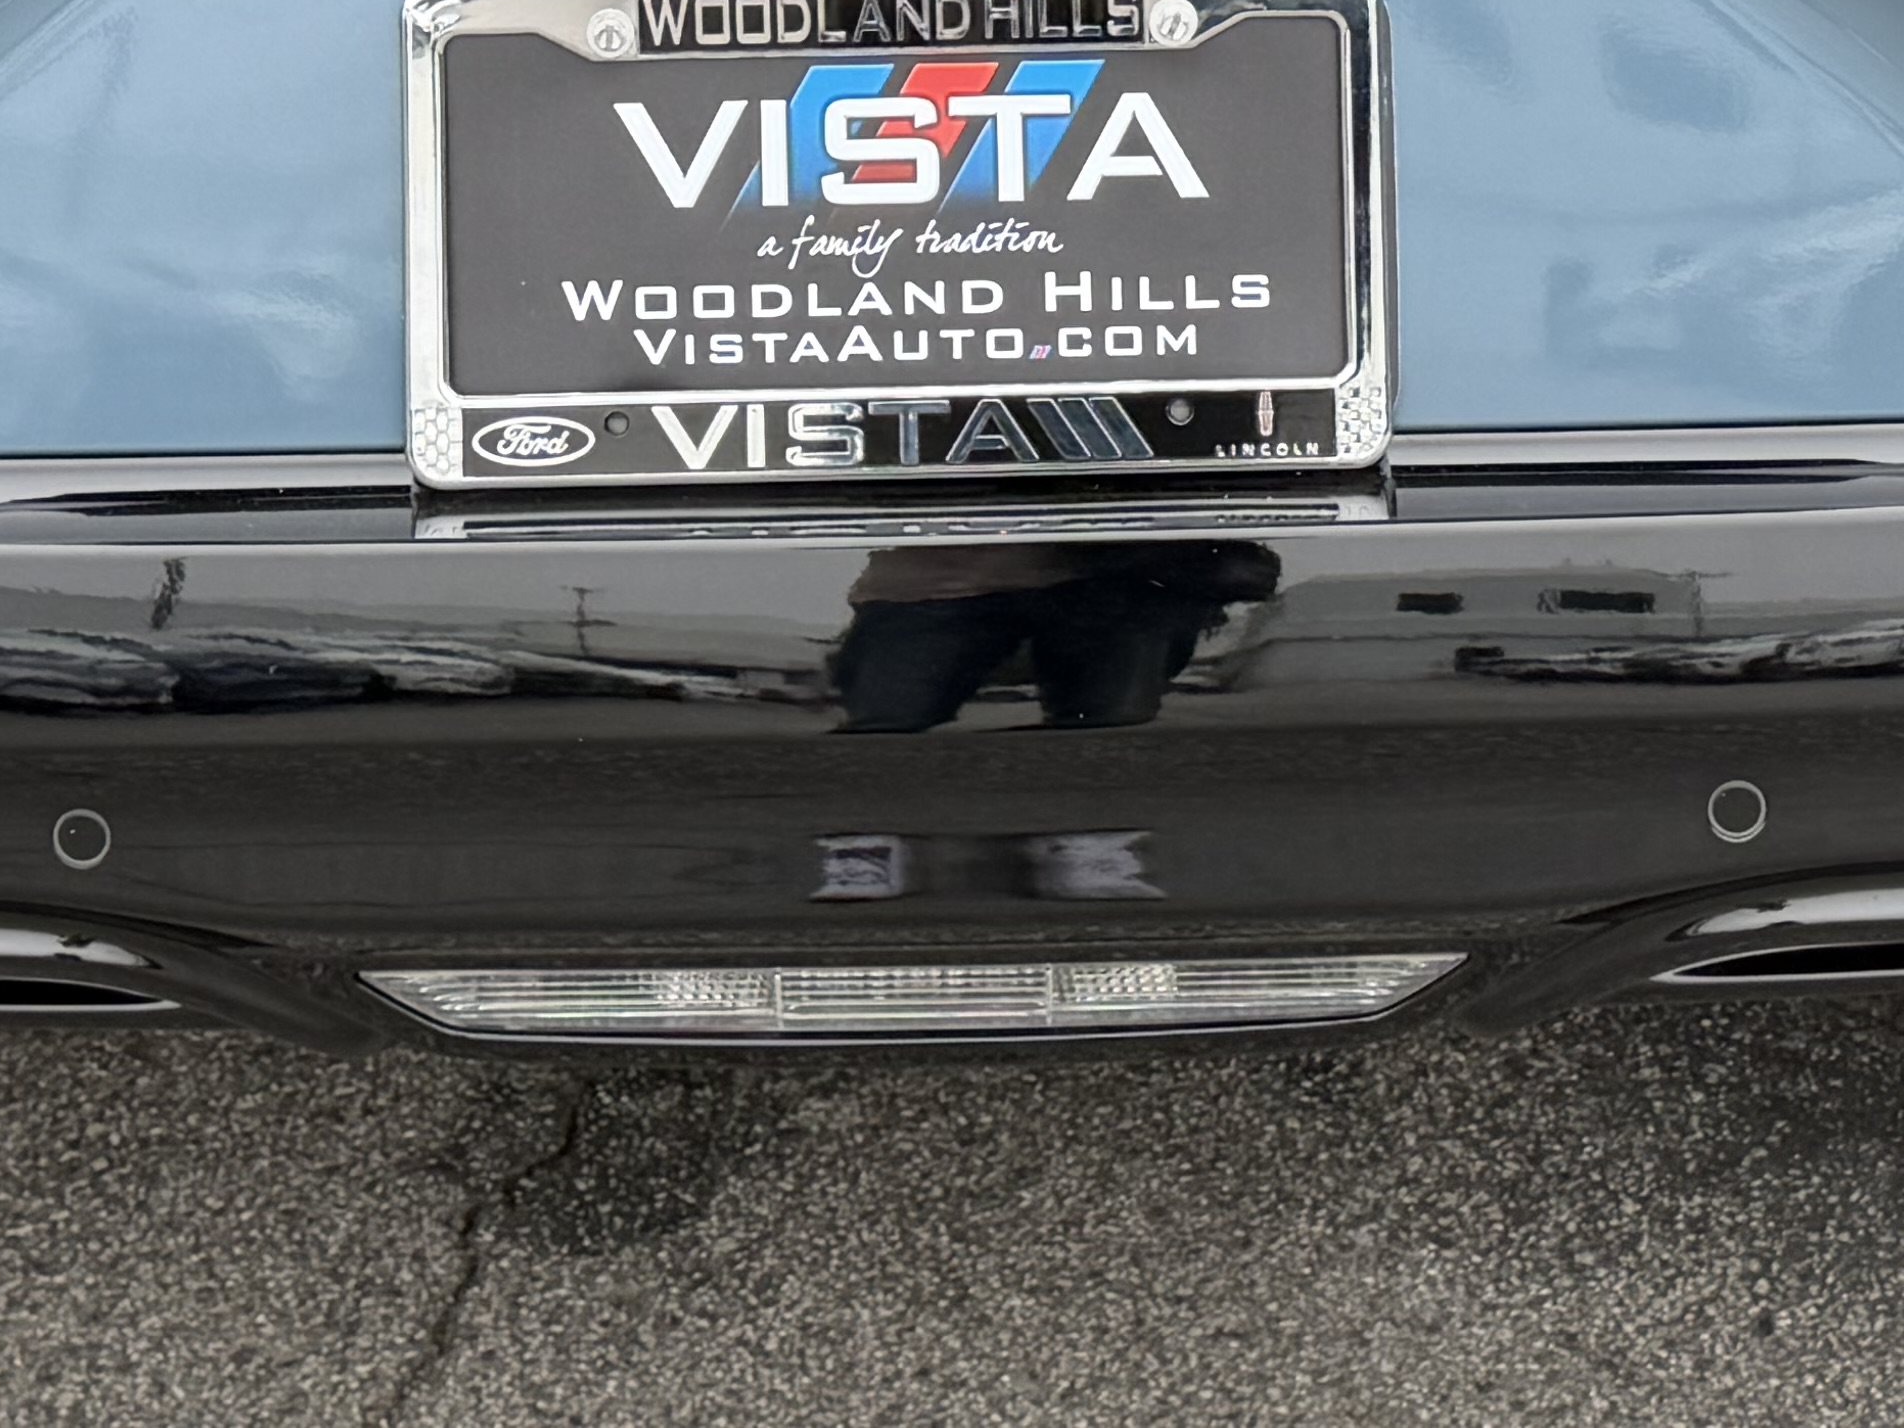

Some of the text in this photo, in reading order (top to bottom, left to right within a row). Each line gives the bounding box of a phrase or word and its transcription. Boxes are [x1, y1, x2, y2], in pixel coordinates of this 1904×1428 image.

[612, 91, 1211, 209] VISTA
[757, 217, 1066, 278] a family tradition
[560, 270, 1272, 323] WOODLAND HILLS
[633, 324, 1199, 366] VISTAAUTO.COM
[496, 424, 570, 457] Ford
[650, 397, 1041, 470] VISTA
[1213, 442, 1322, 458] LINCOLN
